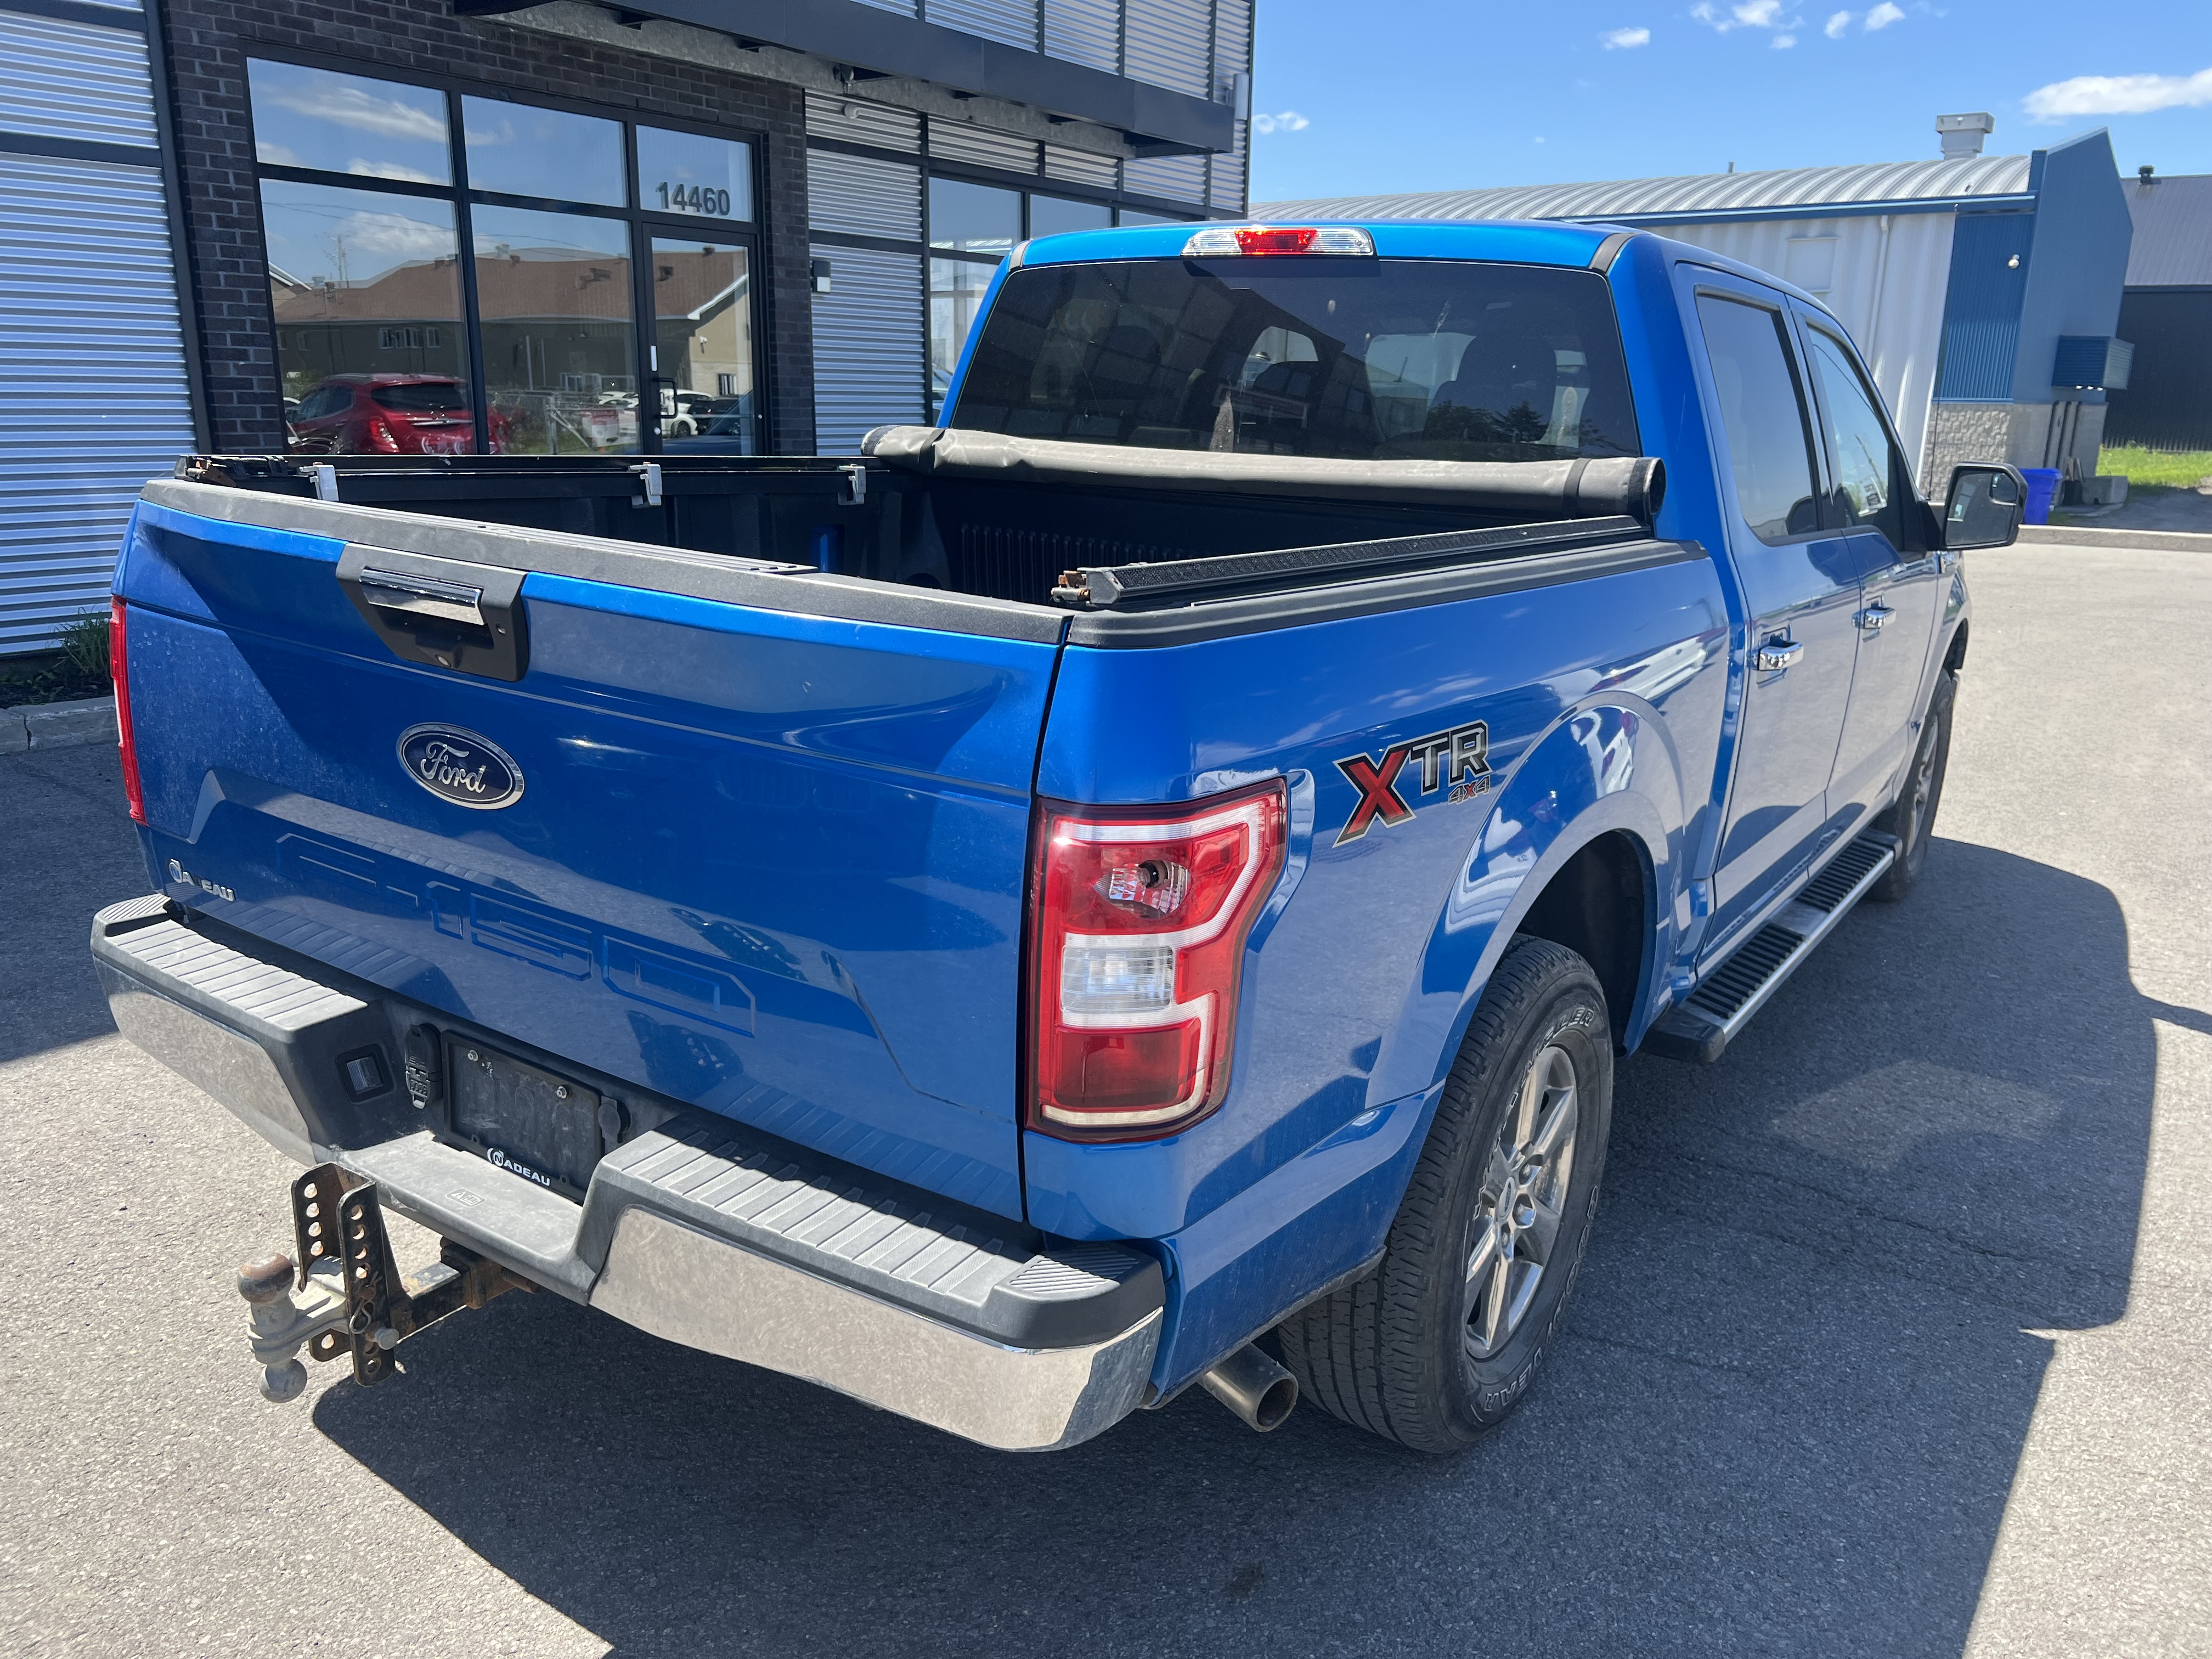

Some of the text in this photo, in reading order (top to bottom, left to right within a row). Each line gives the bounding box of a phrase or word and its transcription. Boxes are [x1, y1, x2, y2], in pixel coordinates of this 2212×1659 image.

[656, 182, 730, 216] 14460
[420, 741, 487, 793] Ford
[1331, 719, 1493, 849] XTR
[168, 859, 236, 901] NAEAU
[487, 1148, 551, 1186] NADEAU
